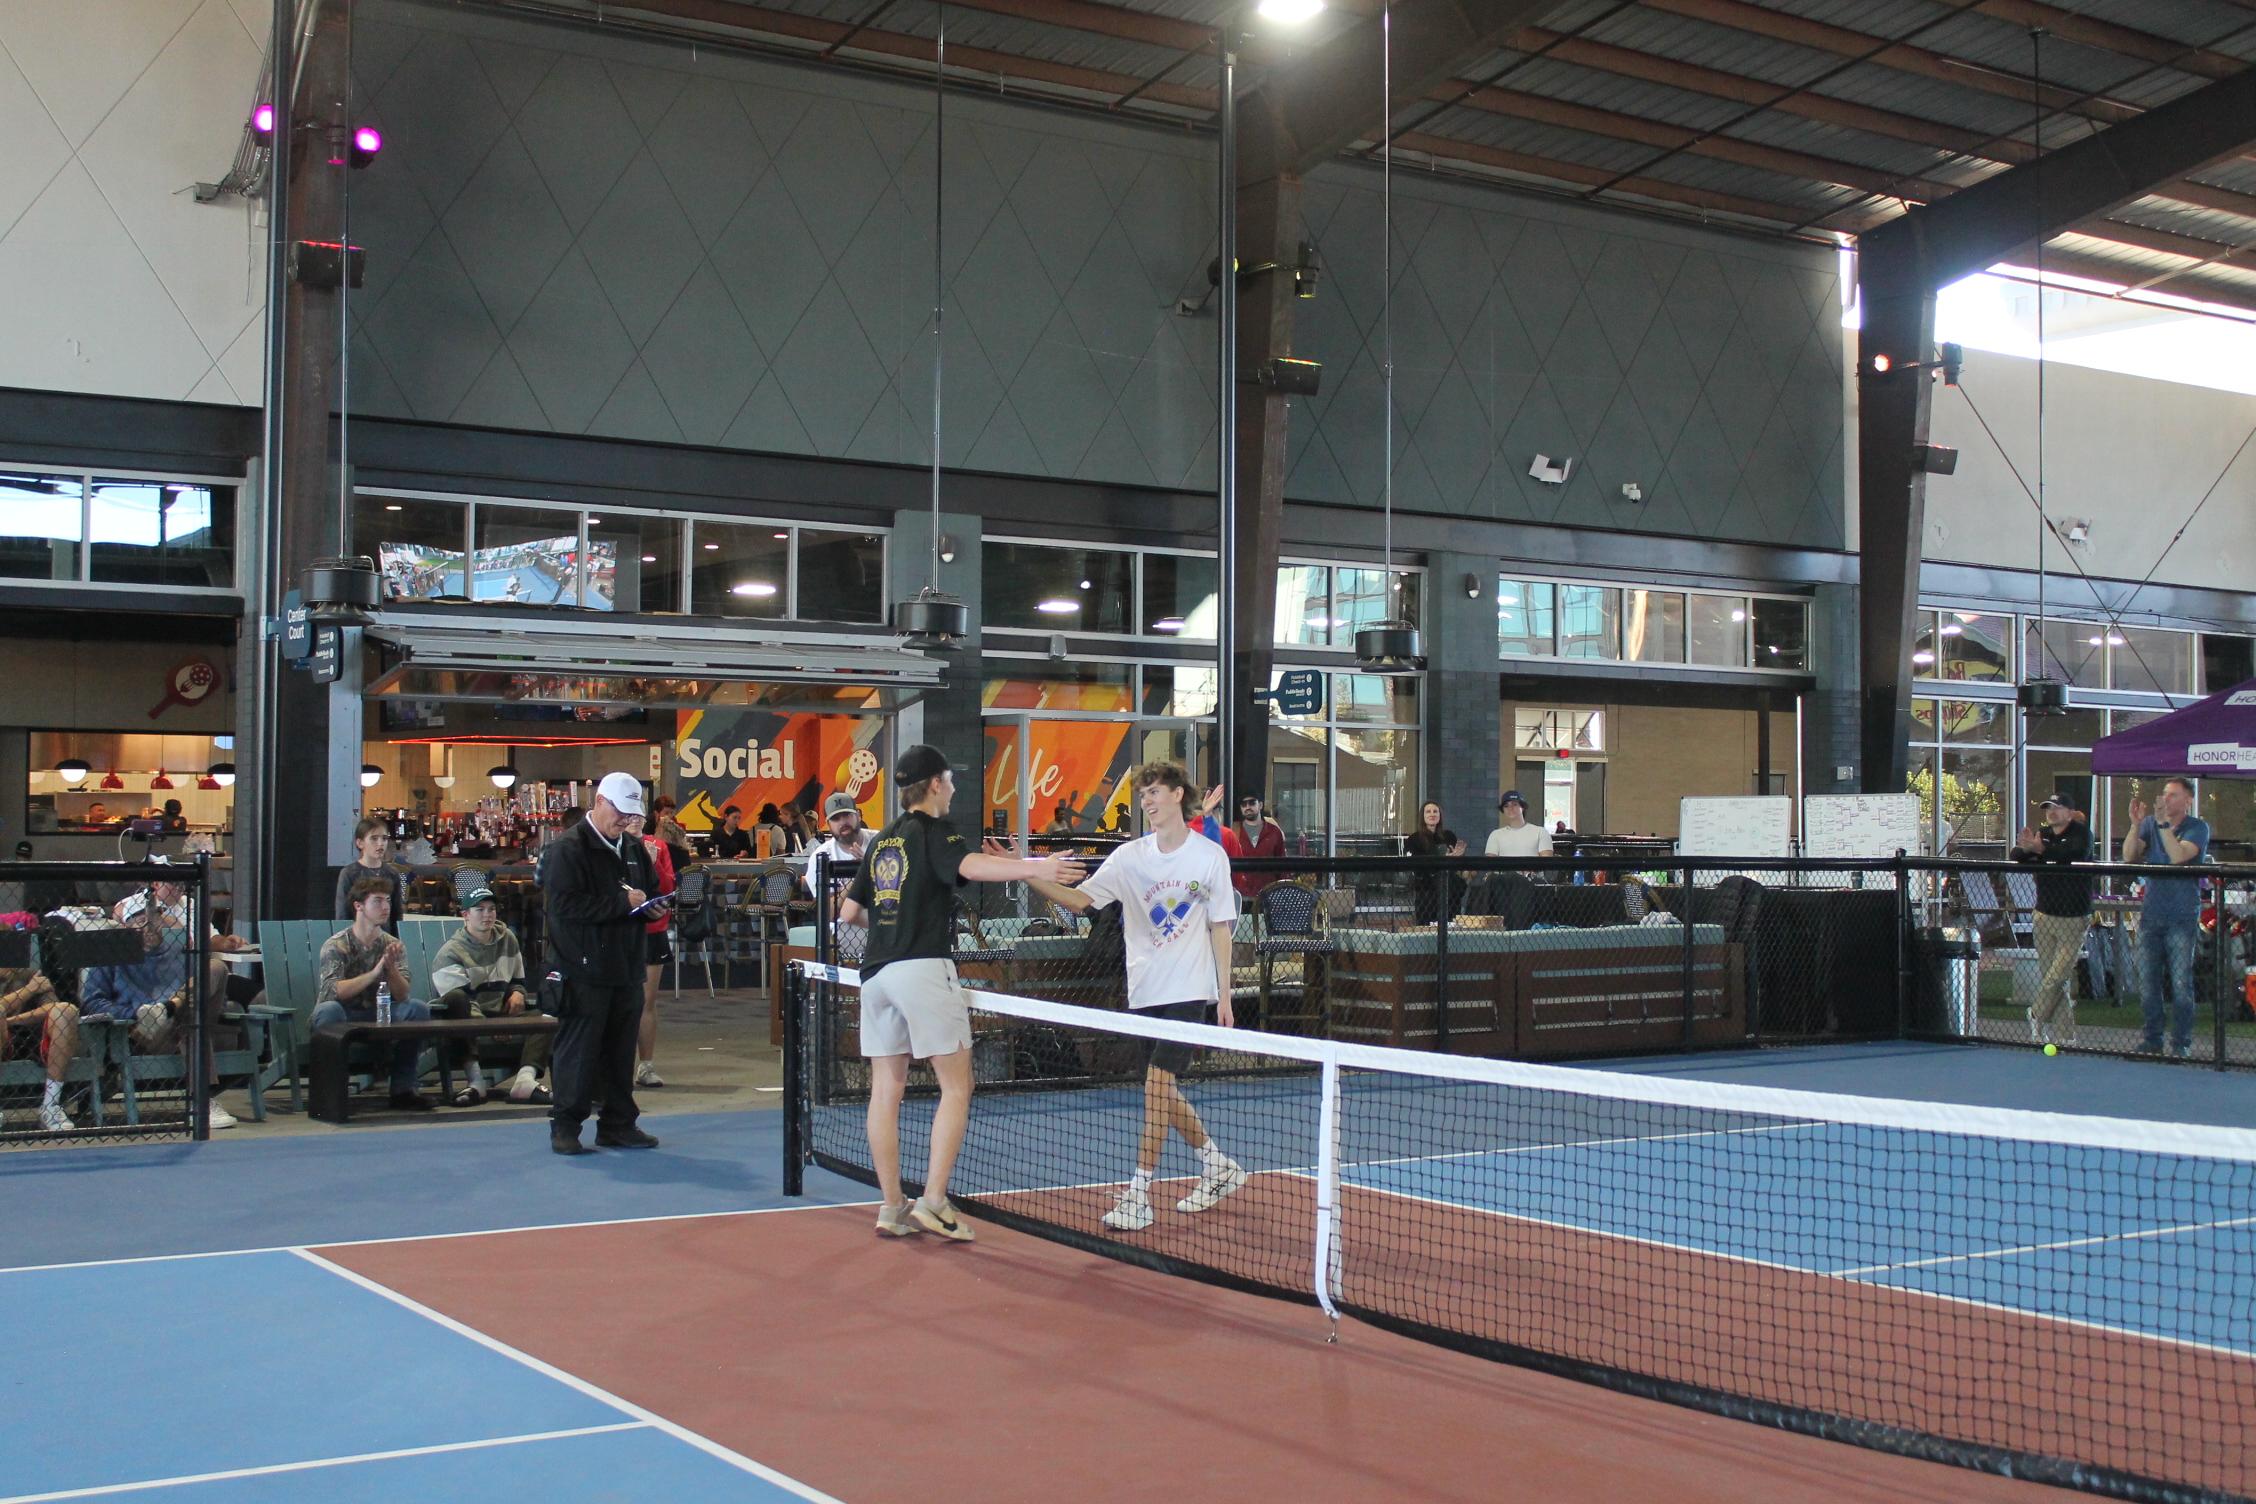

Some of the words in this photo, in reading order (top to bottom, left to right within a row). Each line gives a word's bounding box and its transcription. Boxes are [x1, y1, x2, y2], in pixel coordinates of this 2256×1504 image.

[287, 609, 306, 623] Center
[288, 625, 305, 640] Court
[680, 738, 795, 779] Social
[1143, 879, 1182, 903] MOUNTAIN
